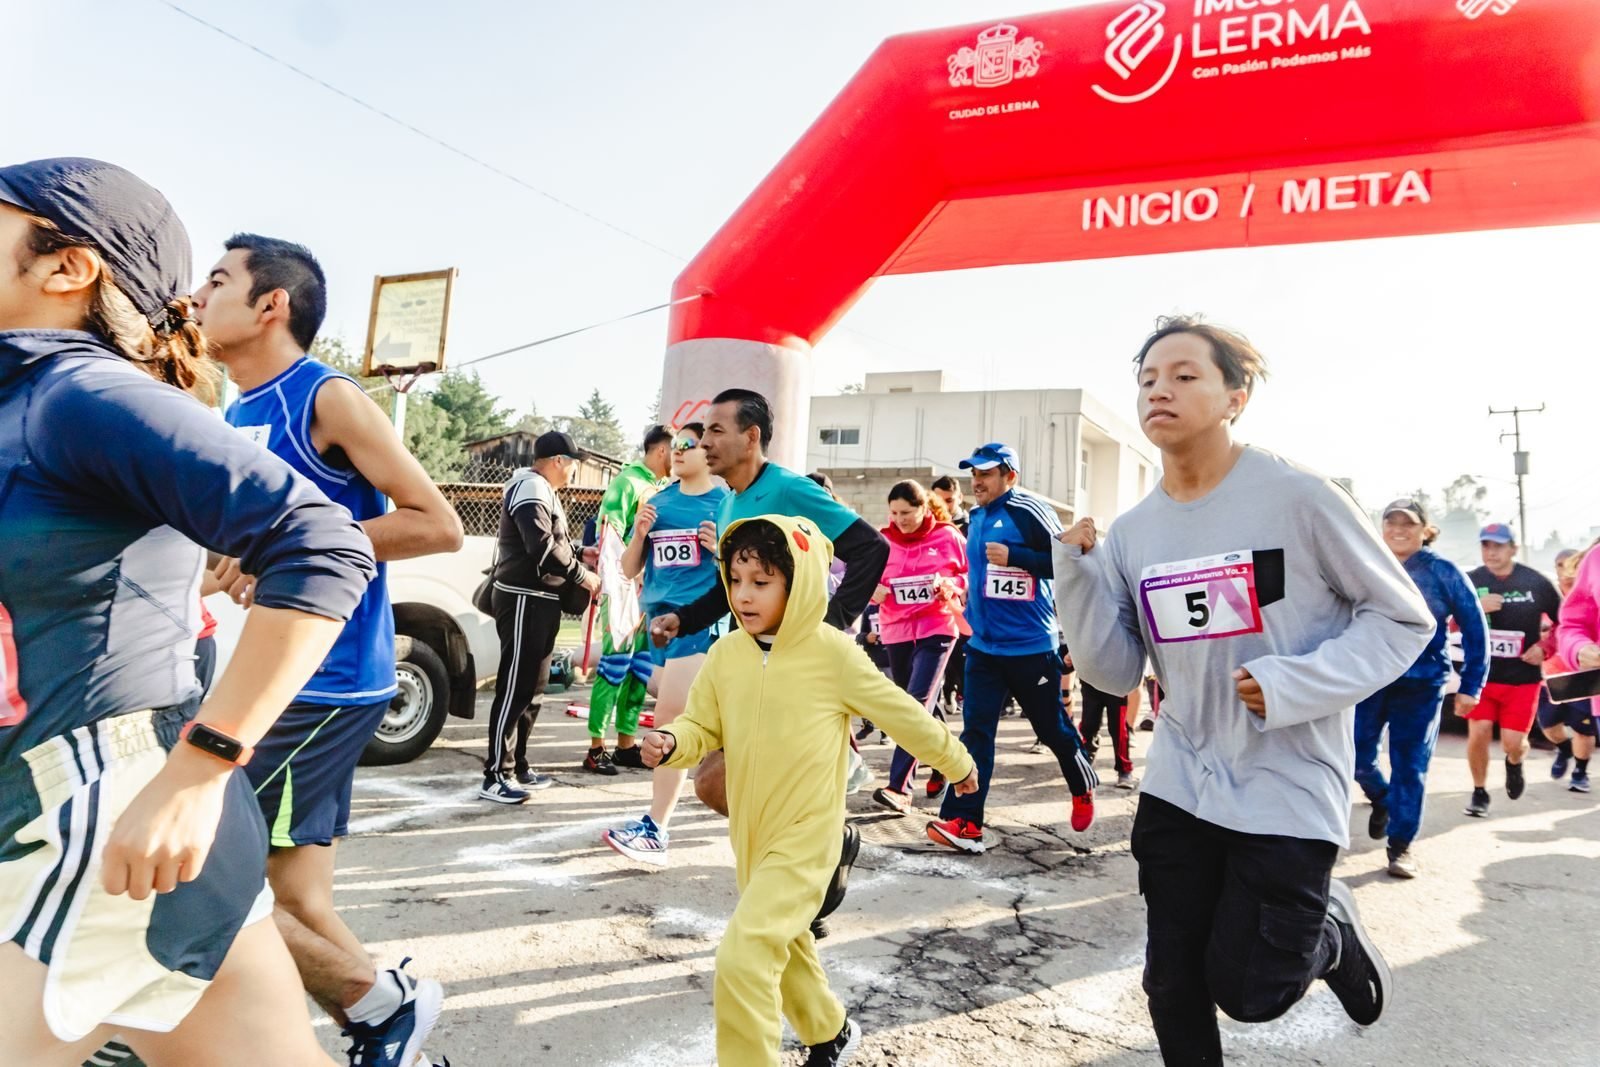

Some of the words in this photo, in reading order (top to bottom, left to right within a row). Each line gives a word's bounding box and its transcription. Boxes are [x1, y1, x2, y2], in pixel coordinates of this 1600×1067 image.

[1192, 0, 1372, 58] LERMA
[1192, 66, 1219, 79] Con
[1222, 59, 1268, 75] Pasión
[1271, 51, 1338, 69] Podemos
[1341, 45, 1372, 59] Más
[949, 107, 985, 120] CIUDAD
[986, 105, 1000, 115] DE
[1001, 100, 1040, 113] LERMA
[1081, 187, 1219, 231] INICIO
[1282, 170, 1432, 214] META
[657, 544, 691, 562] 108
[899, 588, 929, 601] 144
[993, 579, 1026, 596] 145
[1185, 590, 1210, 628] 5
[1489, 641, 1513, 654] 141
